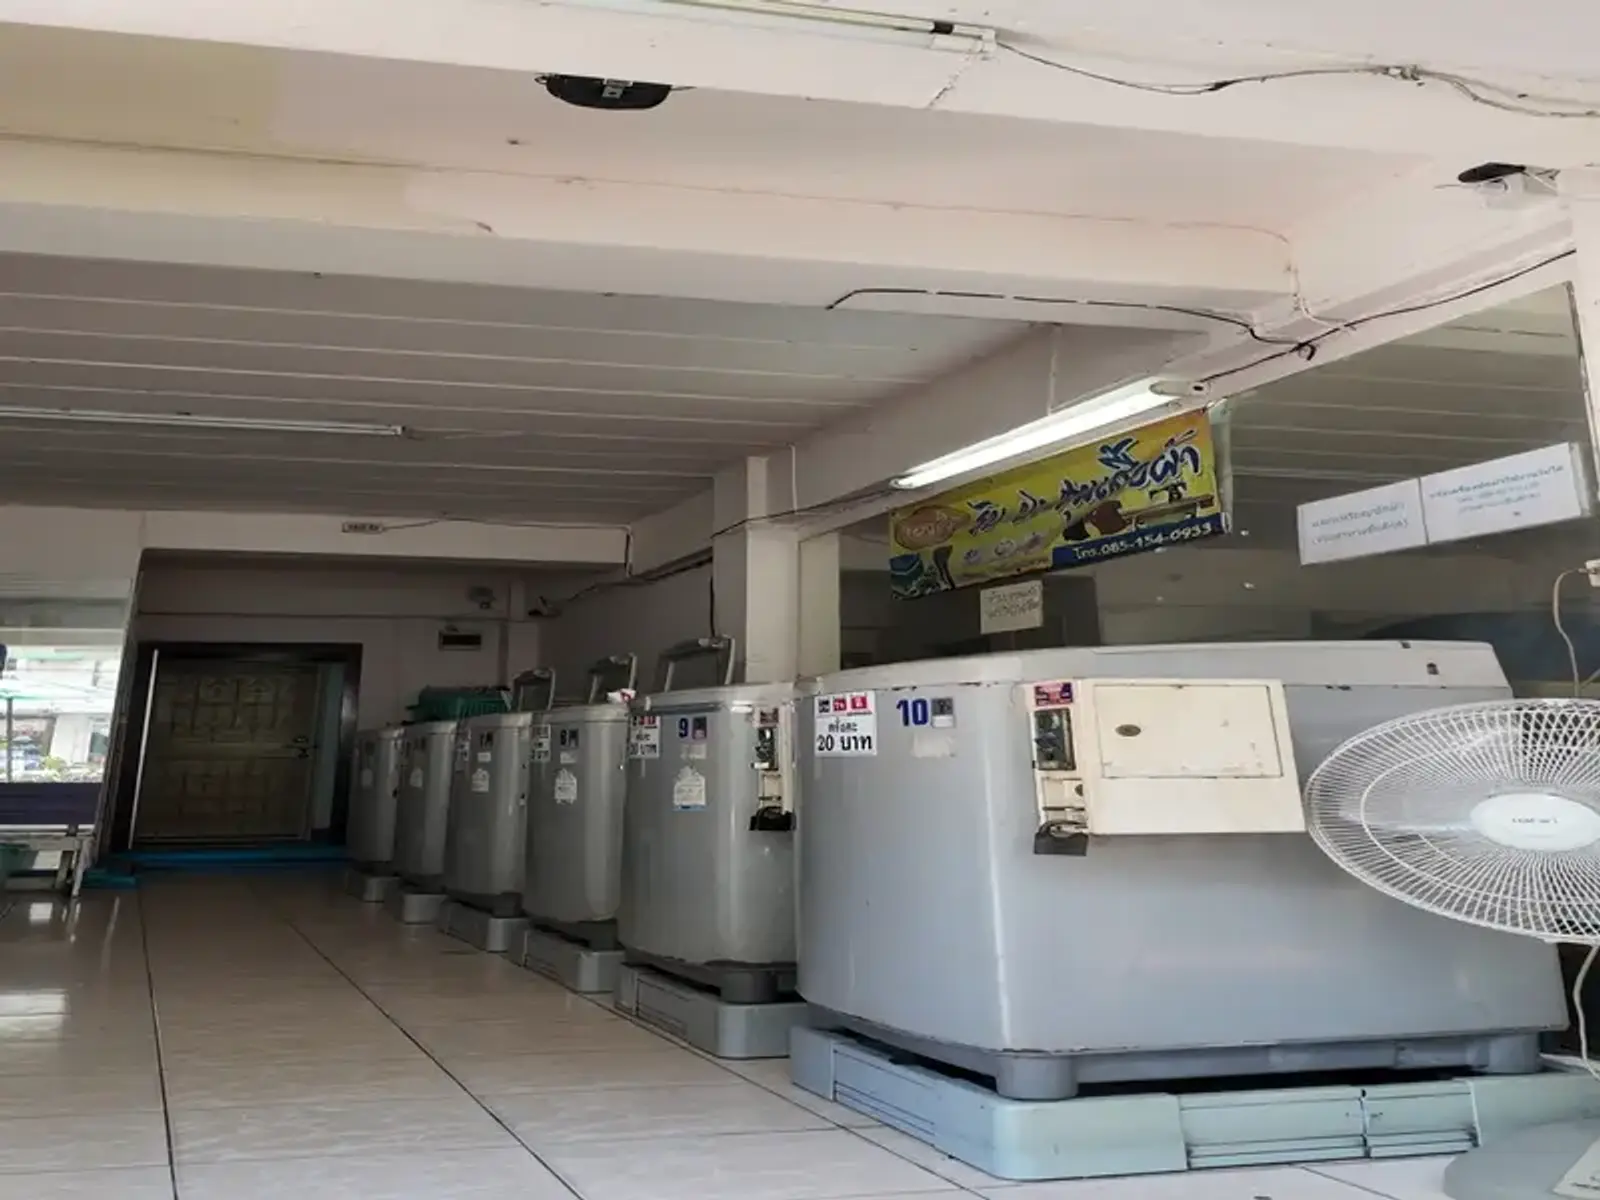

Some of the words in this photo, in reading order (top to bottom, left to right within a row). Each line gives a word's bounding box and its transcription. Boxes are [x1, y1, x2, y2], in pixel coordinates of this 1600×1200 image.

[896, 697, 930, 727] 10
[678, 717, 690, 739] 9
[816, 734, 835, 752] 20
[840, 735, 873, 751] บาท
